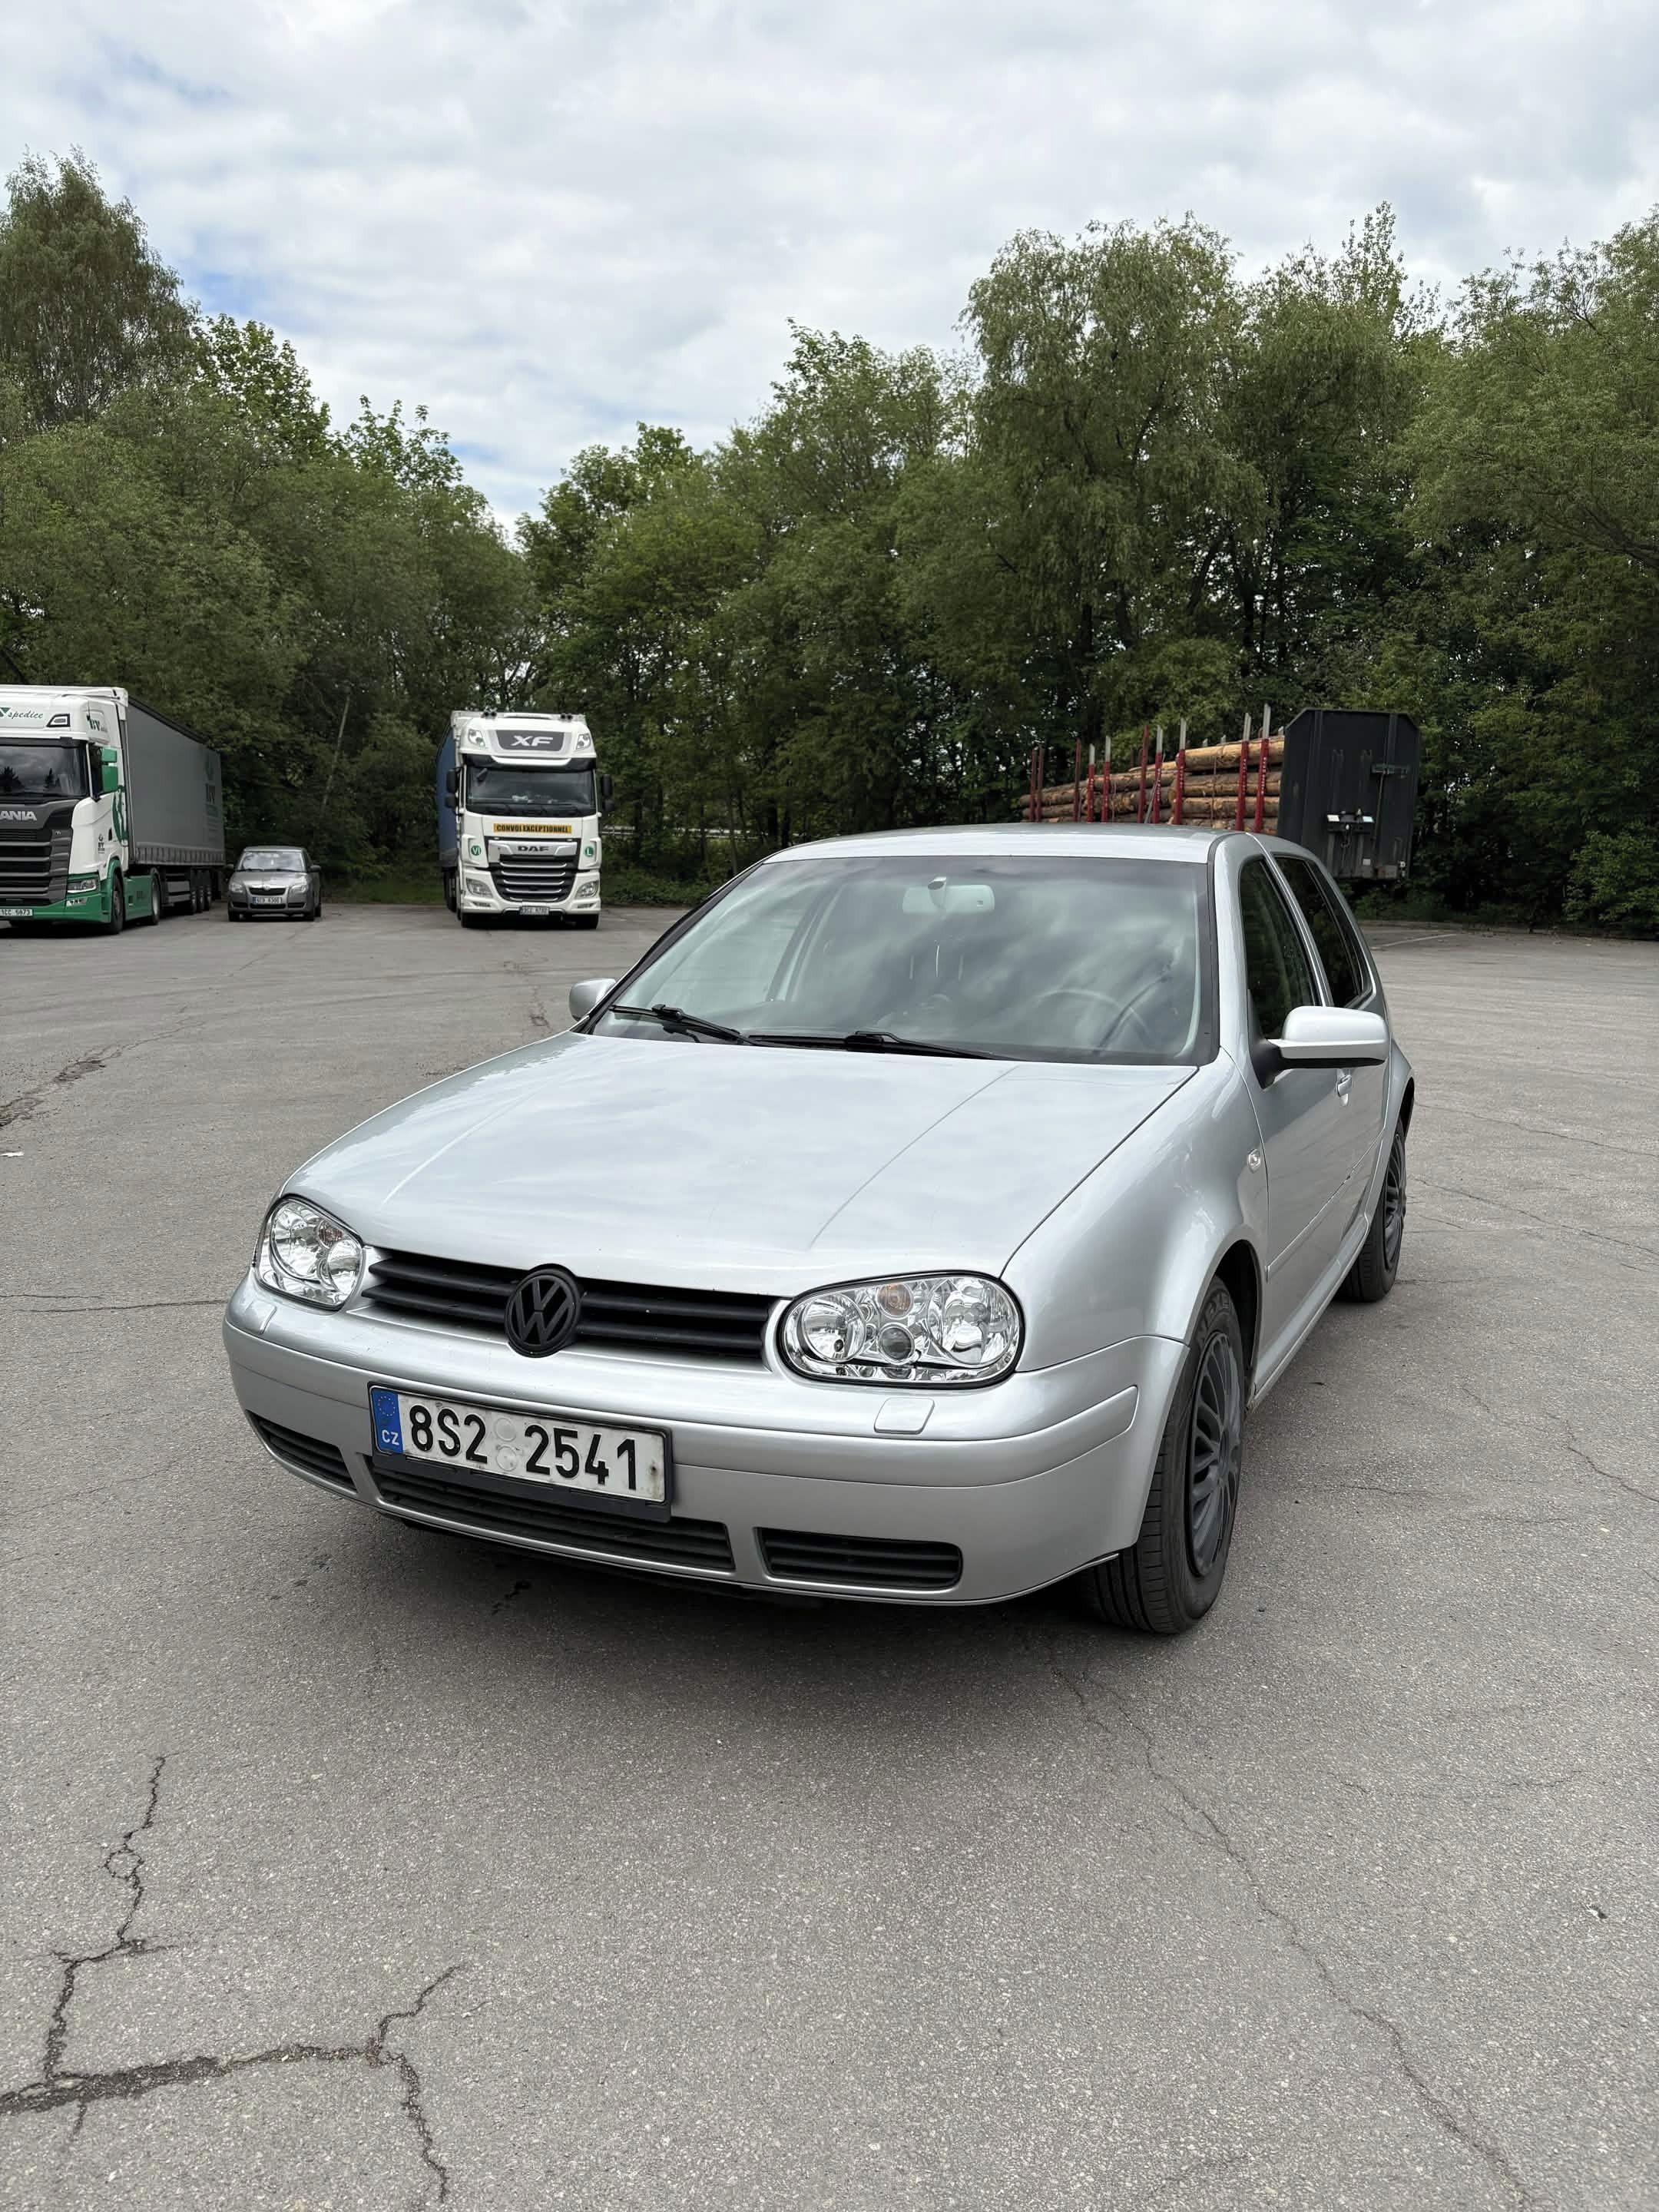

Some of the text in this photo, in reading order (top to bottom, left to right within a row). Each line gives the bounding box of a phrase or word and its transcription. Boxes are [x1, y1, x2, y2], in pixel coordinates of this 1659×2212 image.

[510, 735, 554, 747] XF
[0, 810, 38, 821] ANIA
[496, 823, 522, 833] CONVOI
[587, 847, 592, 856] L
[381, 1429, 400, 1446] CZ
[409, 1404, 637, 1491] 8S2 2541
